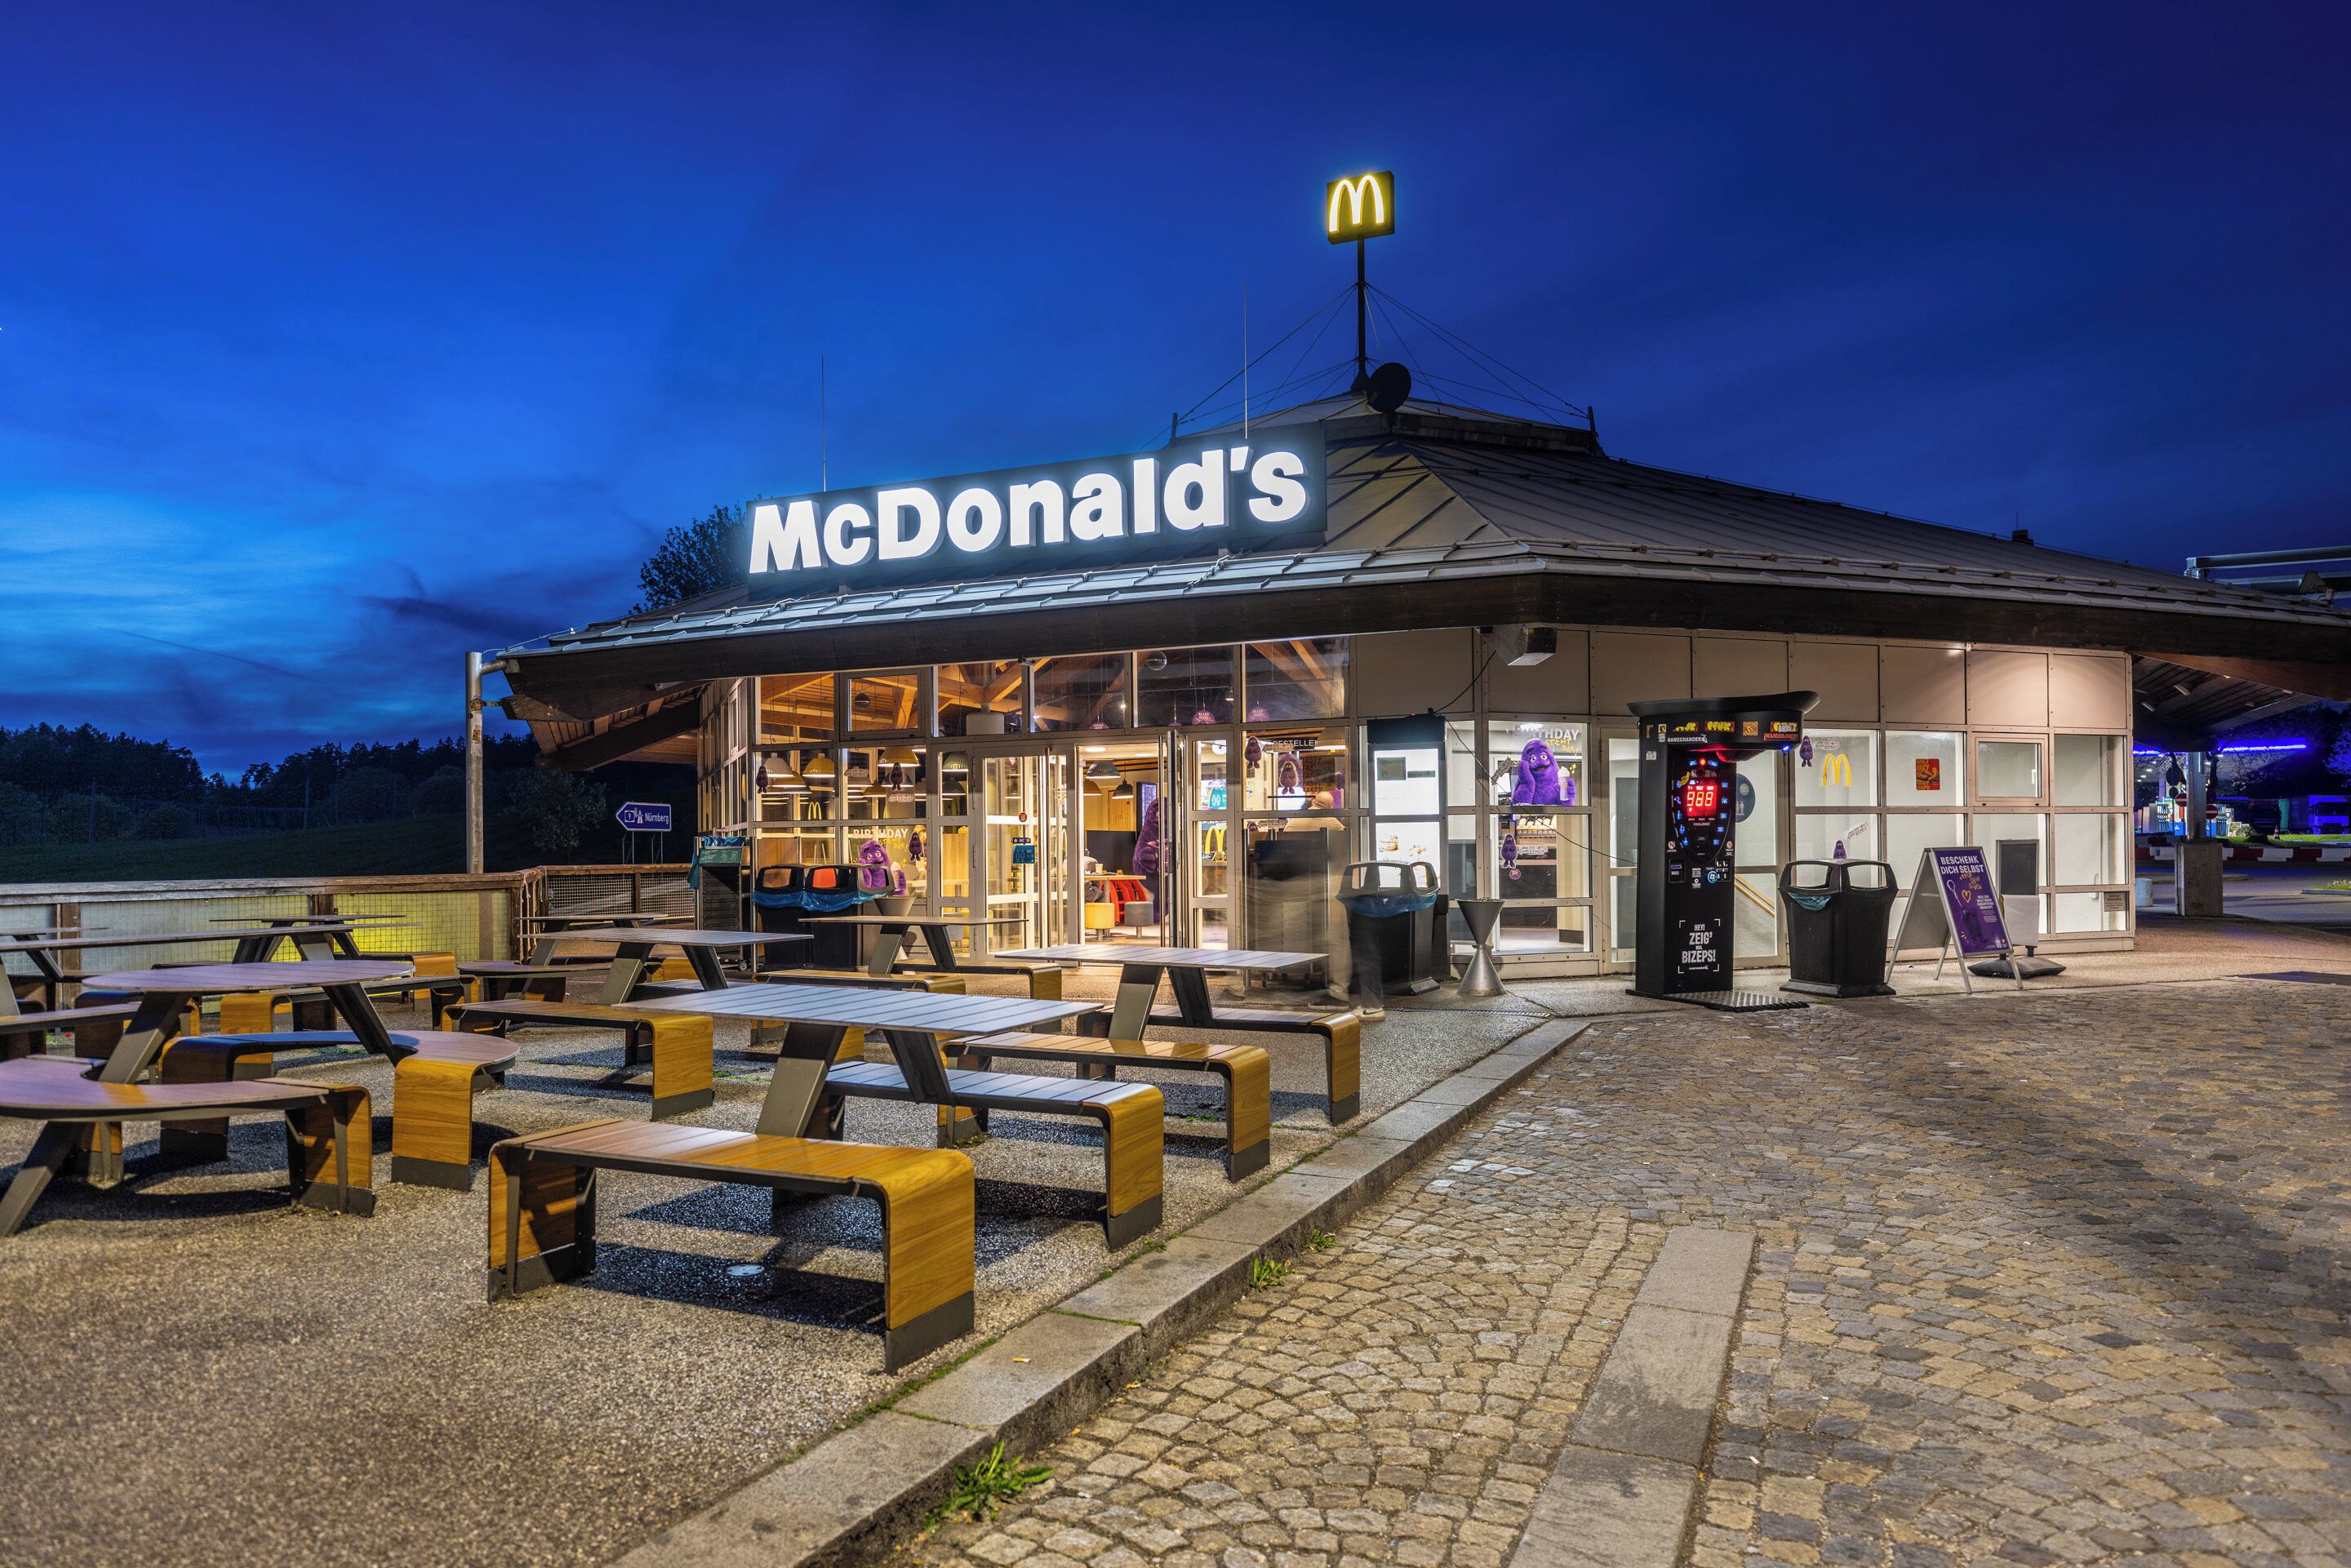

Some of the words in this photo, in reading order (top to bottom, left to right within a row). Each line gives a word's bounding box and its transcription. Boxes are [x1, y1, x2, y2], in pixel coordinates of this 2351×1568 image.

[749, 446, 1307, 574] McDonald's
[1545, 737, 1571, 746] STEHT
[645, 812, 669, 824] Nürnberg
[853, 828, 909, 839] BIRTHDAY
[1940, 855, 1980, 865] BESCHENK
[1940, 866, 1959, 874] DICH
[1959, 864, 1984, 873] SELBST
[1689, 931, 1713, 945] ZEIG'
[1682, 949, 1716, 963] BIZEPS!
